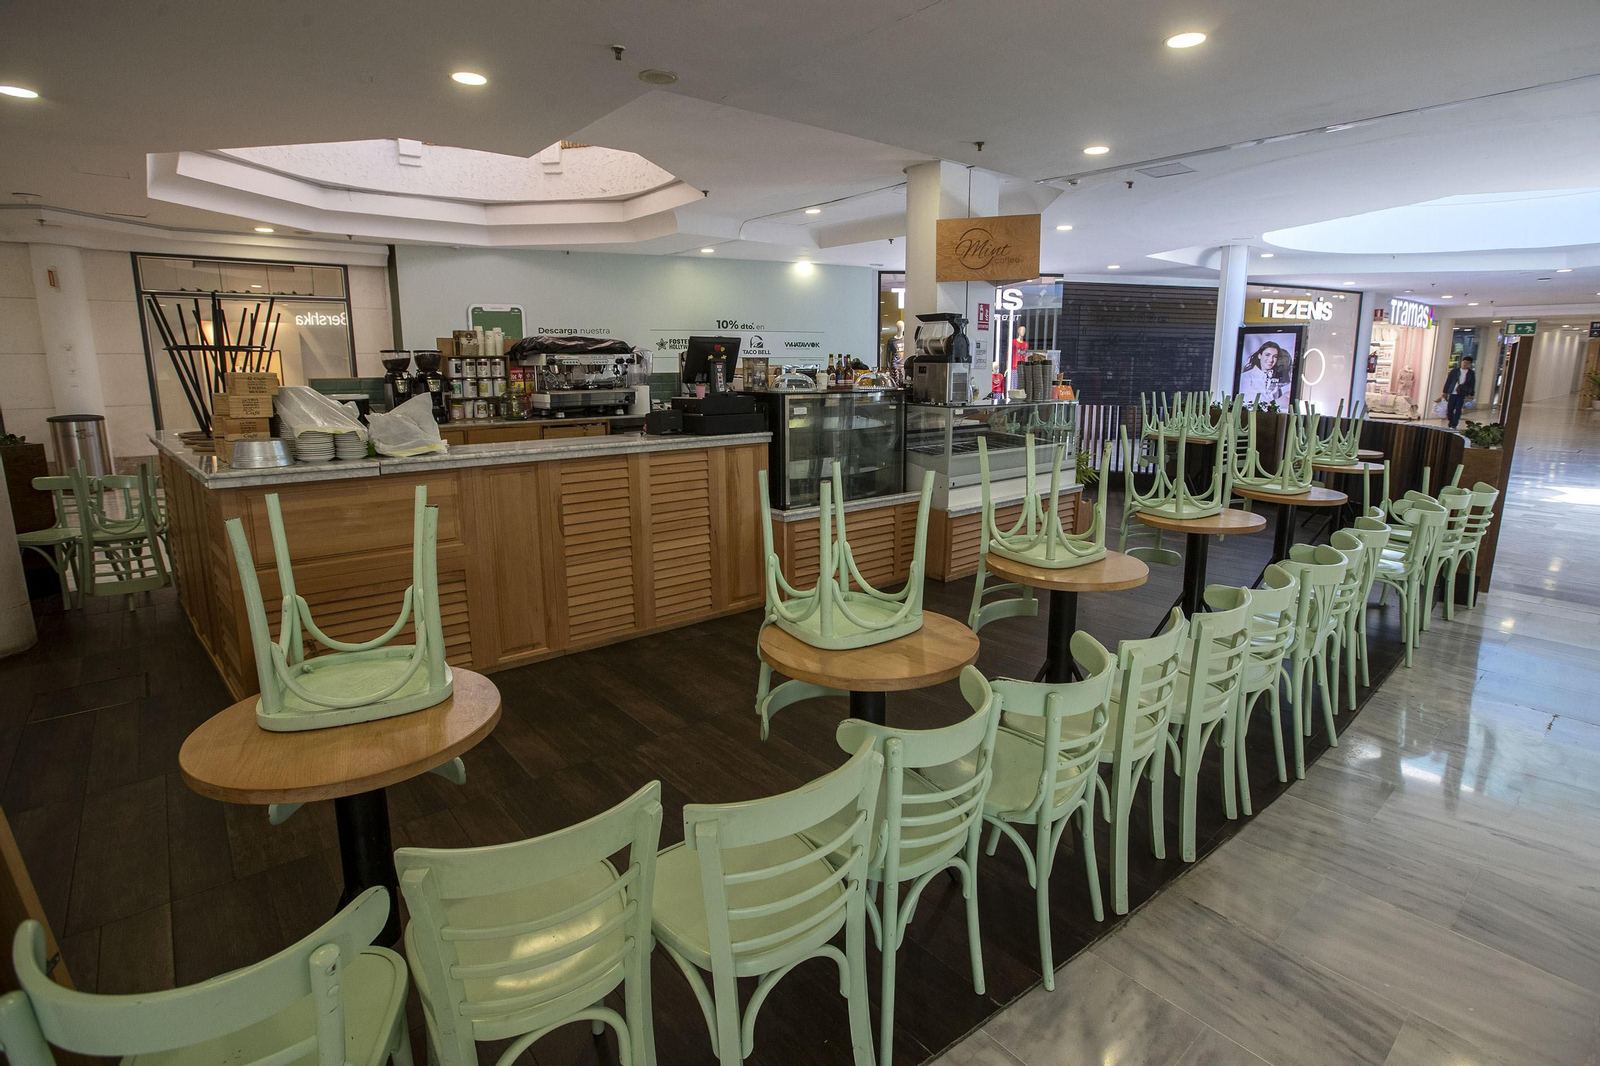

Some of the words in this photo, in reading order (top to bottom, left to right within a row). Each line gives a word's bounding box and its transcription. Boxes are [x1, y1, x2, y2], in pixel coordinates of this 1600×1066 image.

[955, 239, 1012, 258] Mint
[1260, 297, 1333, 321] TEZENIS
[538, 327, 578, 335] Descarga
[716, 320, 739, 329] 10%
